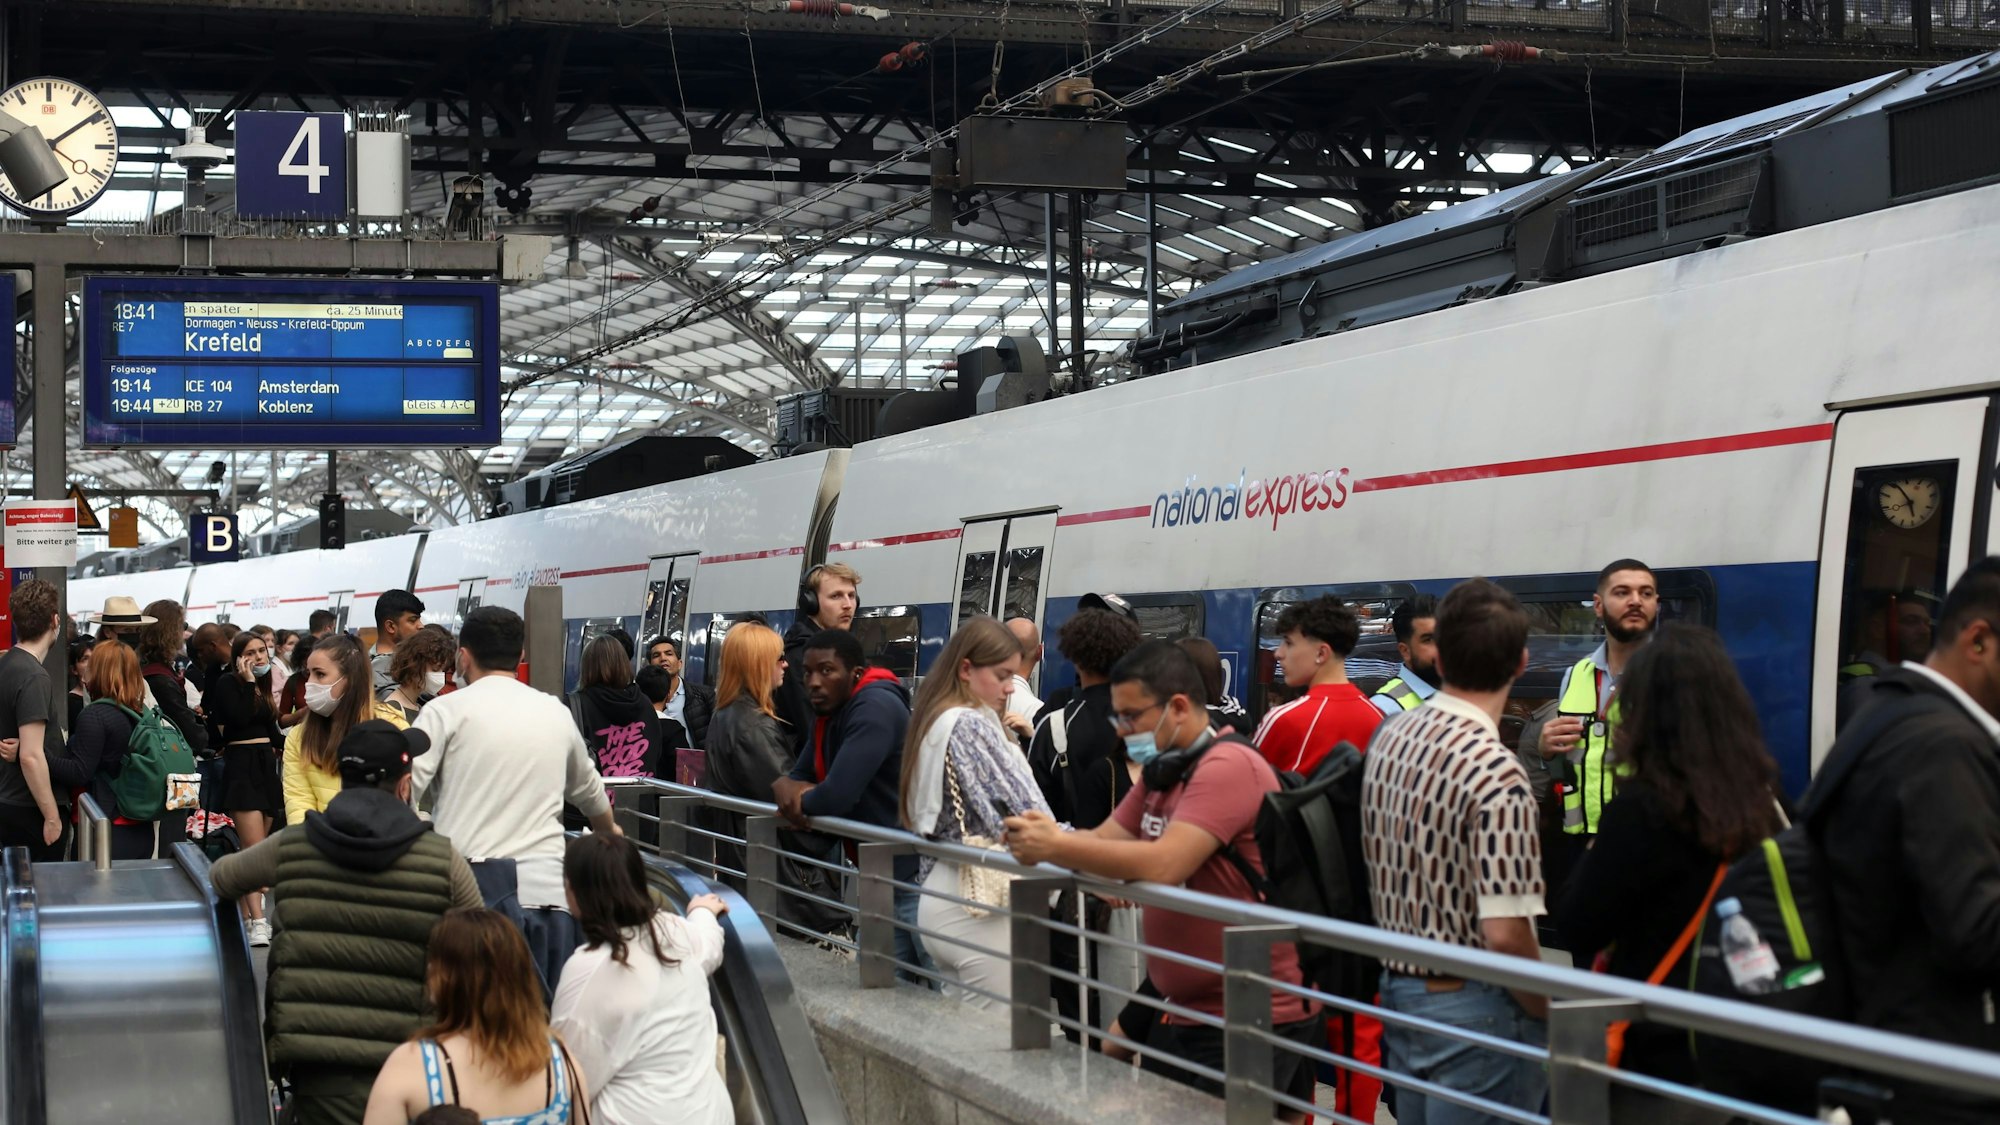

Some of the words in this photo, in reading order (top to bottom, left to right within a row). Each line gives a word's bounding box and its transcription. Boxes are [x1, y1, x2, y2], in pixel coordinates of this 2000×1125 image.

[278, 117, 330, 194] 4
[113, 303, 155, 320] 18:41
[326, 306, 345, 316] ca.
[348, 306, 361, 316] 25
[112, 321, 125, 332] RE
[128, 321, 134, 332] 7
[185, 317, 237, 330] Dormagen
[246, 318, 278, 329] Neuss
[288, 319, 365, 332] Krefeld-Oppum
[185, 331, 261, 351] Krefeld
[110, 365, 157, 374] Folgezüge
[112, 379, 151, 393] 19:14
[185, 380, 205, 393] ICE
[210, 380, 232, 393] 104
[258, 380, 339, 394] Amsterdam
[112, 399, 151, 413] 19:44
[158, 399, 180, 408] +20
[185, 401, 203, 412] RB
[207, 401, 223, 412] 27
[258, 400, 313, 414] Koblenz
[407, 400, 436, 409] Gleis
[440, 400, 446, 409] 4
[450, 400, 470, 409] A-C
[1152, 467, 1246, 529] national
[1245, 467, 1350, 532] express
[207, 516, 233, 552] B
[16, 538, 35, 546] Bitte
[595, 721, 646, 751] THE
